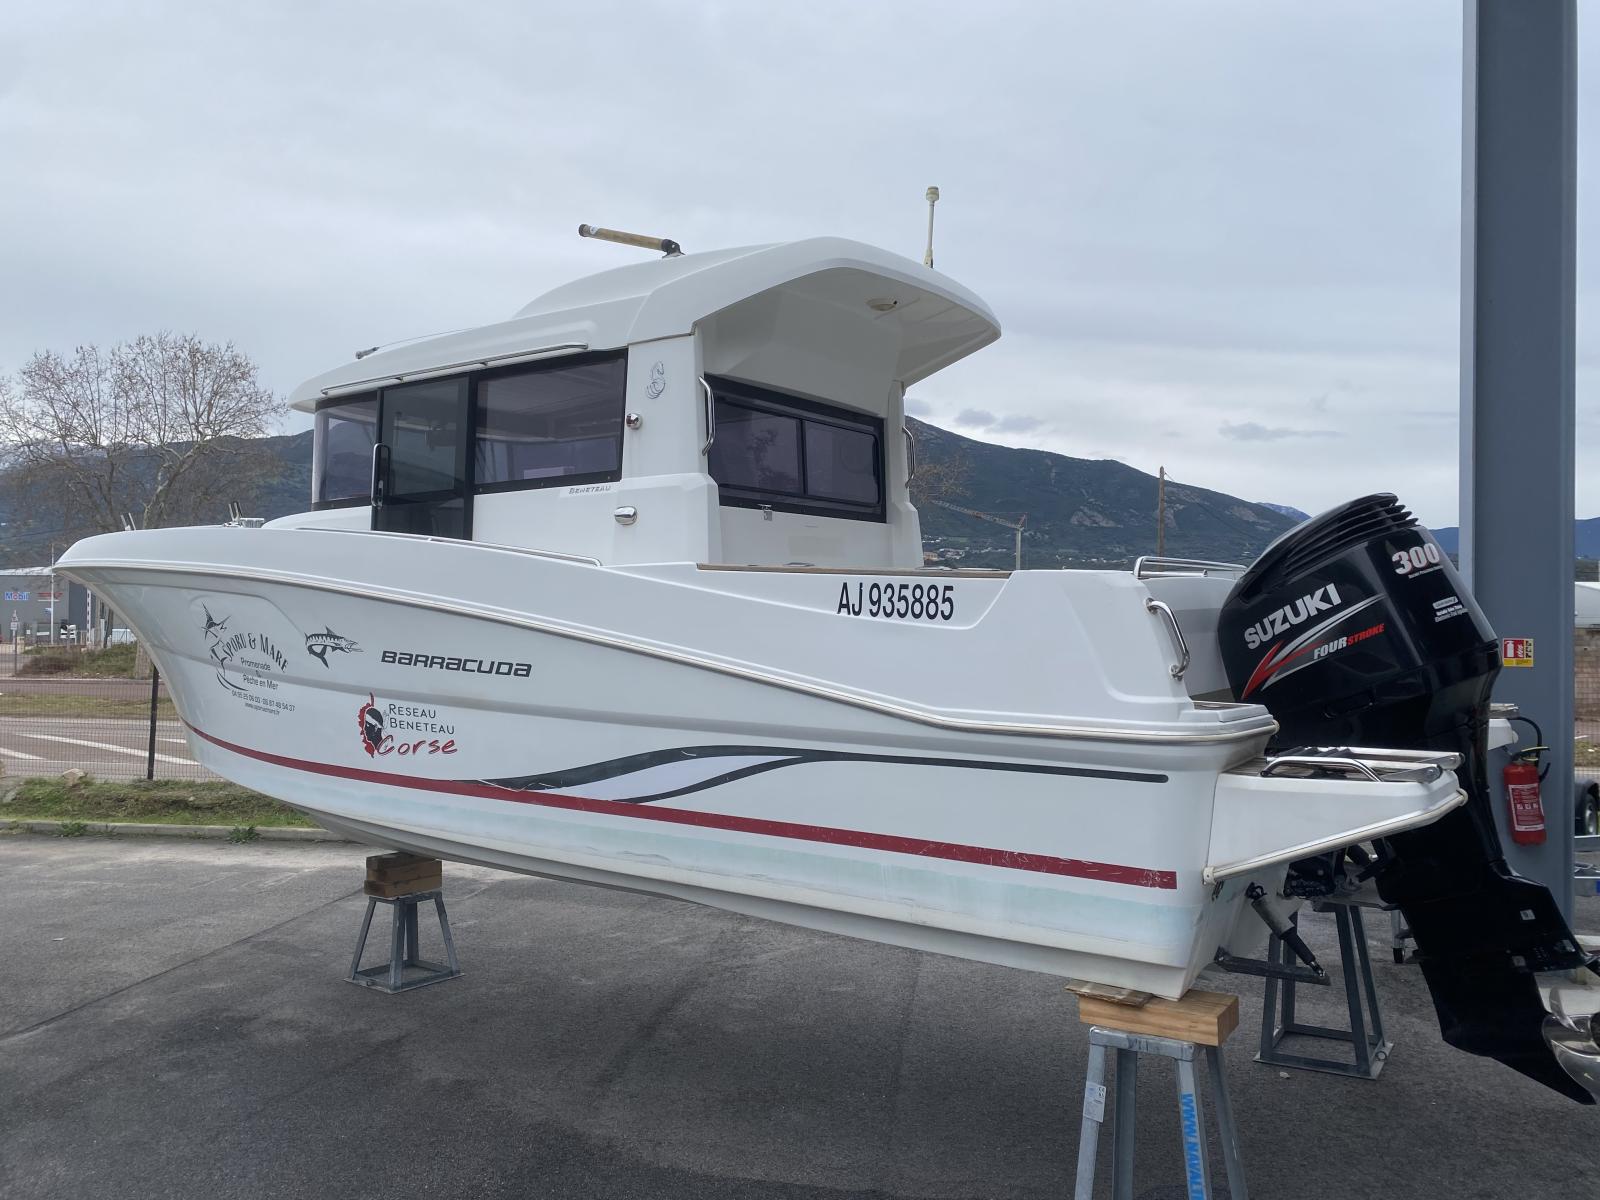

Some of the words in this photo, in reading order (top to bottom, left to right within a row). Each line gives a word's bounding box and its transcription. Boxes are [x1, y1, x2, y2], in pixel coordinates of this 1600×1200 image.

[569, 485, 612, 495] BENETEAU
[1392, 542, 1440, 575] 300
[5, 592, 29, 600] Mobil
[837, 582, 863, 616] AJ
[869, 582, 954, 620] 935885
[1244, 583, 1342, 649] SUZUKI
[248, 633, 256, 649] &
[260, 634, 288, 673] MARE
[241, 657, 271, 670] Promenade
[267, 680, 278, 690] Mer
[390, 718, 454, 734] BENETEAU
[375, 734, 458, 756] Corse
